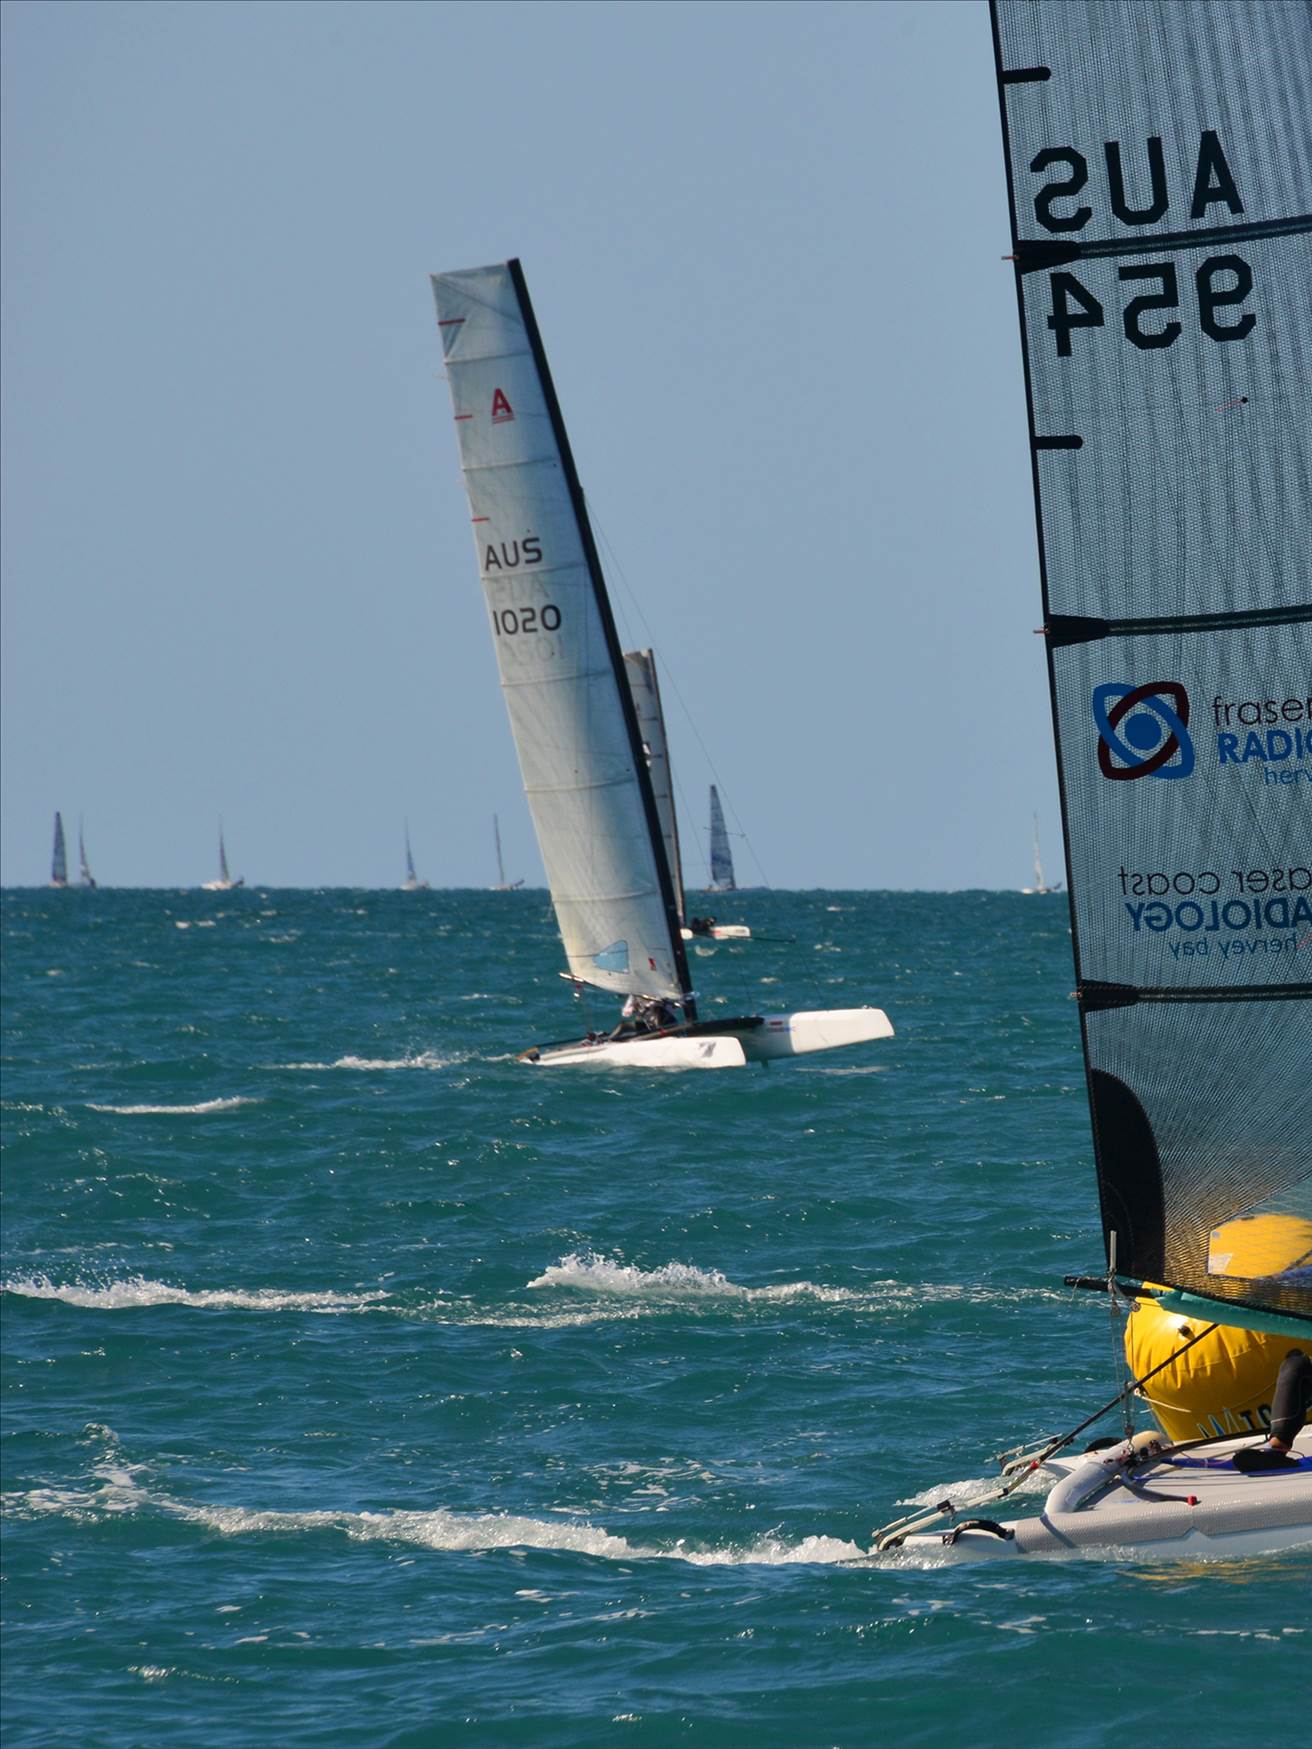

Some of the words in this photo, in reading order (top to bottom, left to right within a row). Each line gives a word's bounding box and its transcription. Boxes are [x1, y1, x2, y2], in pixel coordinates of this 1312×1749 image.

[491, 387, 514, 418] A
[484, 536, 543, 572] AUS
[492, 603, 562, 637] 1020
